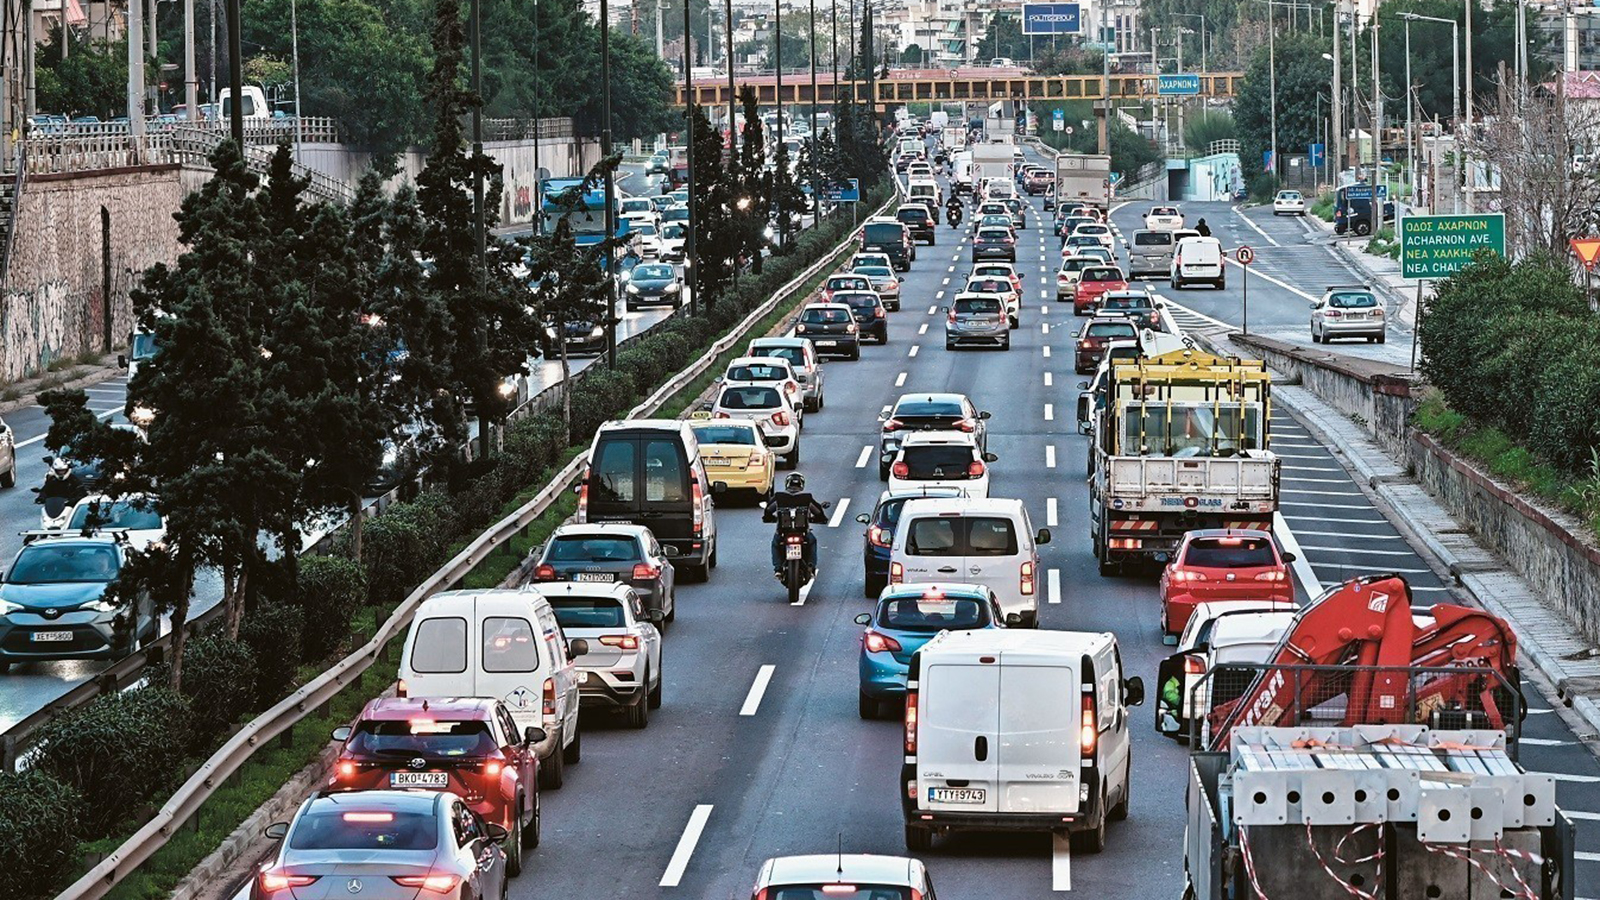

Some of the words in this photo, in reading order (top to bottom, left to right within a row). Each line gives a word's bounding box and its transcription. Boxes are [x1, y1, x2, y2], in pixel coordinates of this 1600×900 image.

[1406, 222, 1433, 232] ΟΔΟΣ
[1437, 220, 1487, 231] ΑΧΑΡΝΩΝ
[1407, 235, 1465, 245] ACHARNON
[1470, 234, 1492, 244] AVE.
[1406, 249, 1429, 259] ΝΕΑ
[1407, 263, 1429, 273] NEA
[398, 774, 417, 783] BKO
[422, 774, 447, 783] 4783
[937, 789, 954, 799] YTY
[960, 789, 983, 800] 9743
